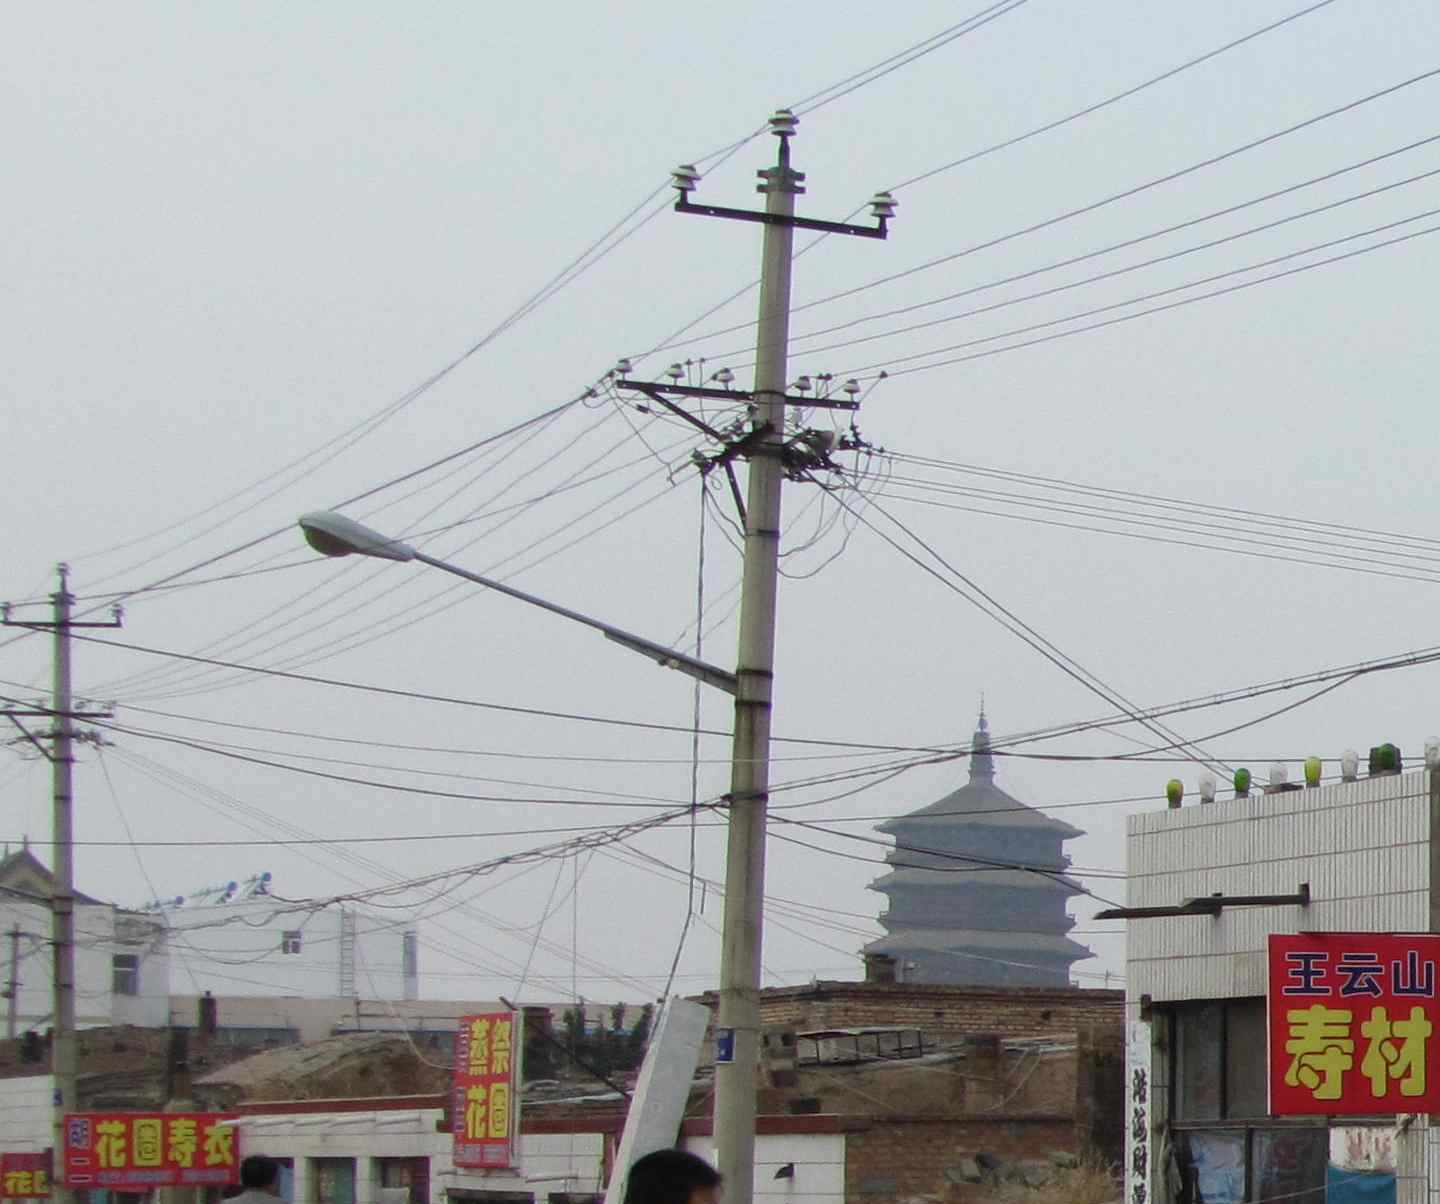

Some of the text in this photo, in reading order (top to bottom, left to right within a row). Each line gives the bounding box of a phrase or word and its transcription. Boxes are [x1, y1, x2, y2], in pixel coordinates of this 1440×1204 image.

[1282, 951, 1435, 998] 王云山
[1284, 1003, 1433, 1100] 寿材
[95, 1118, 234, 1169] 花圈寿衣
